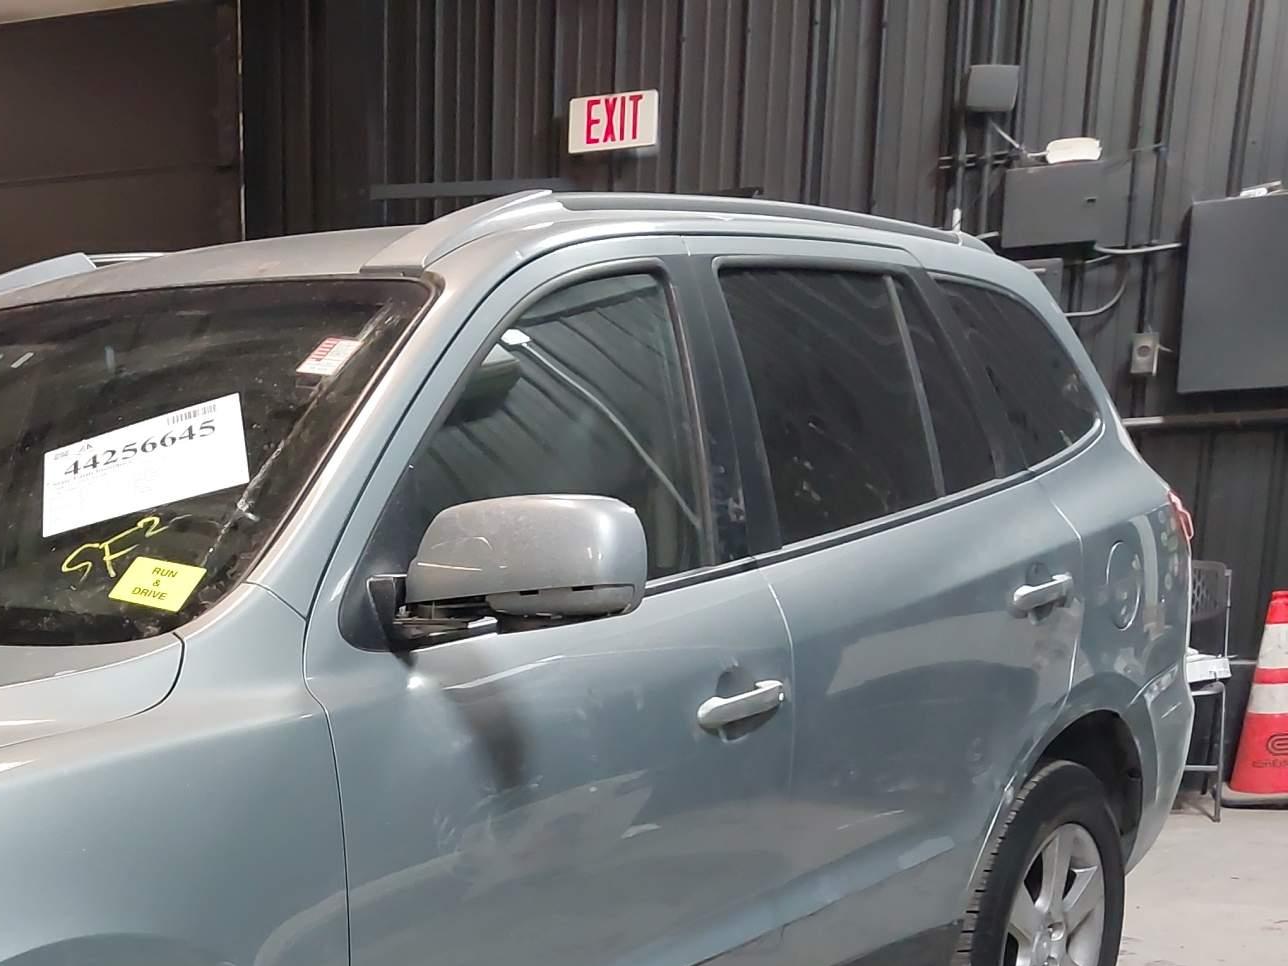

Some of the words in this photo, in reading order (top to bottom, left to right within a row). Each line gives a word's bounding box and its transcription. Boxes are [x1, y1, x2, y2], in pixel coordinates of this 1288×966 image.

[586, 95, 643, 144] EXIT
[64, 419, 216, 476] 44256645
[152, 567, 177, 578] RUN
[152, 579, 161, 588] &
[131, 588, 168, 601] DRIVE
